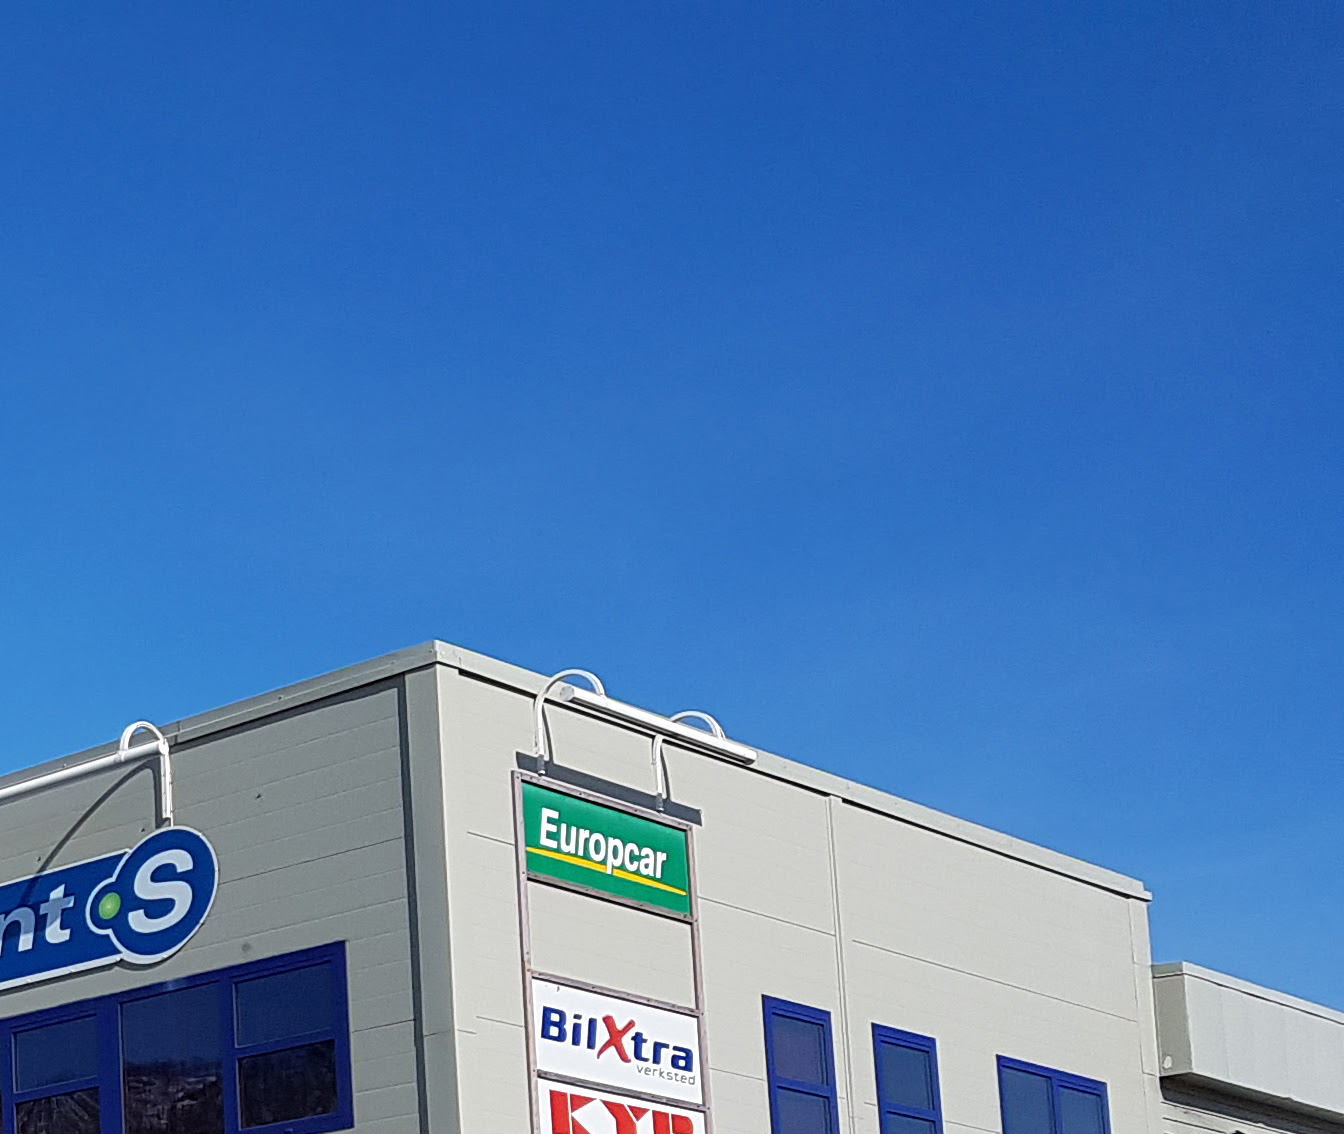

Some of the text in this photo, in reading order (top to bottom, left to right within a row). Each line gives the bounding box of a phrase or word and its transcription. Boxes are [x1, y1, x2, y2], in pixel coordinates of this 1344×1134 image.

[540, 807, 667, 879] Europcar
[128, 849, 193, 933] S
[541, 1006, 694, 1073] BilXtra
[636, 1064, 696, 1086] verksted
